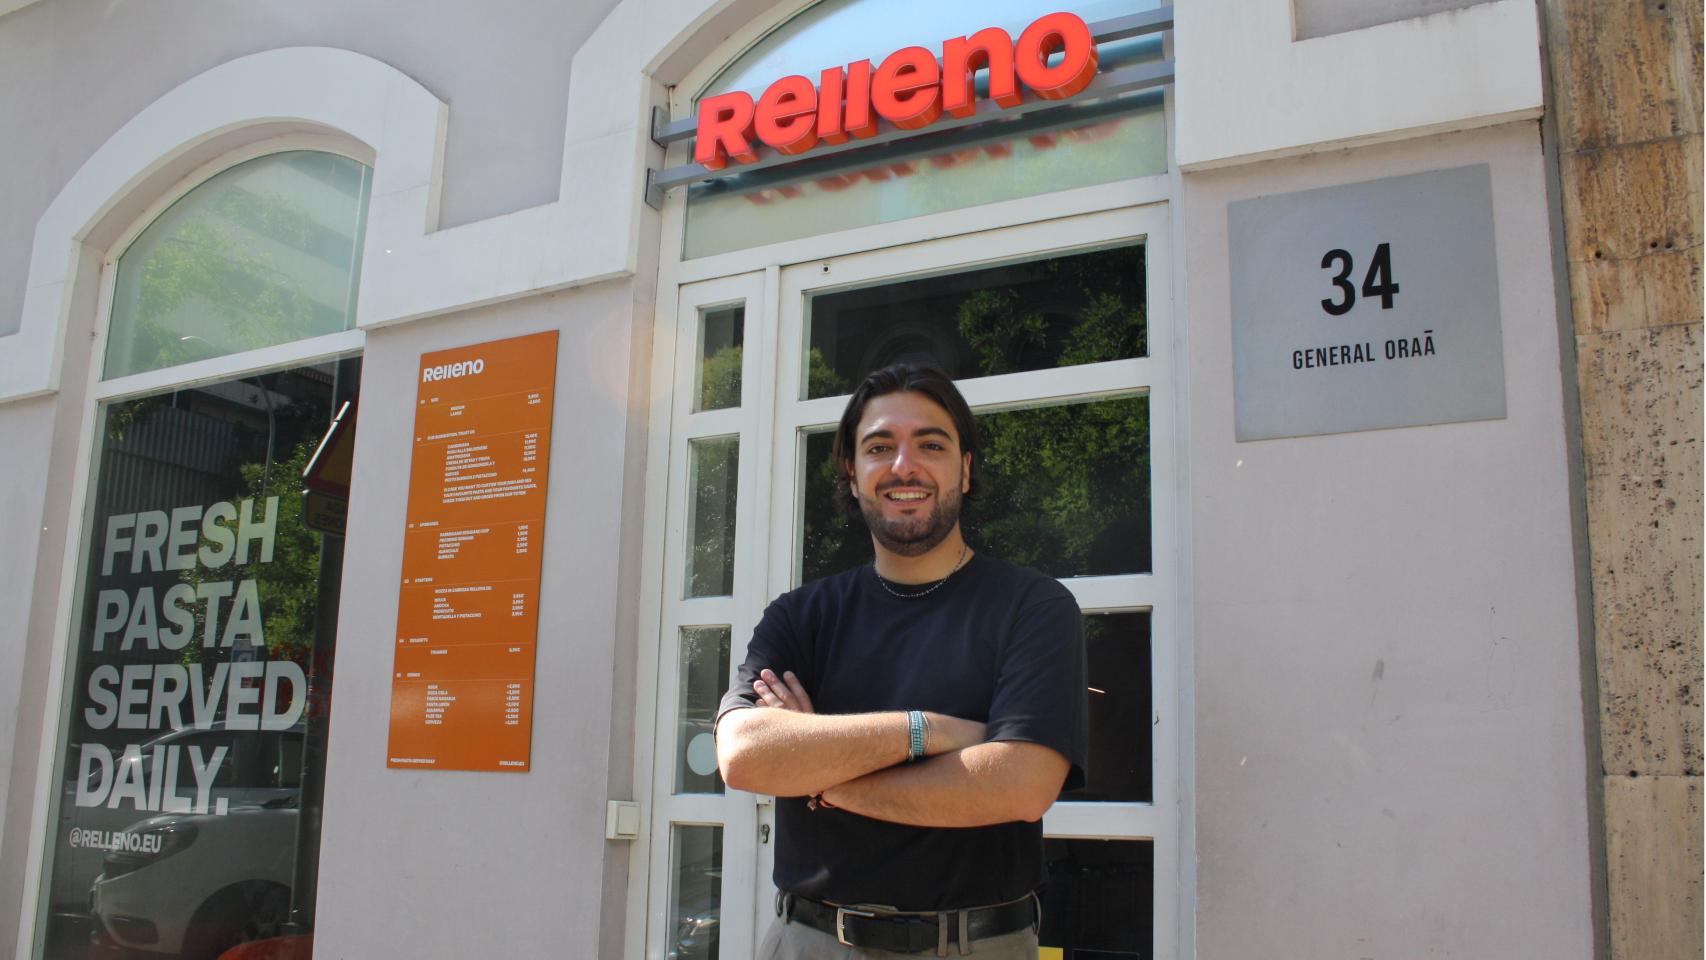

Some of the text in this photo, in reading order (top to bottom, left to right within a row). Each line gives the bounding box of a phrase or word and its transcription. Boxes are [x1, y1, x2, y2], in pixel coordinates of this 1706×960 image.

[694, 11, 1097, 168] Relleno
[1320, 242, 1400, 316] 34
[423, 358, 485, 383] Relleno
[1292, 342, 1375, 370] GENERAL
[101, 496, 280, 576] FRESH
[92, 579, 265, 652] PASTA
[84, 660, 308, 731] SERVED
[74, 742, 230, 816] DAILY.
[69, 827, 162, 854] @RELLENO.EU
